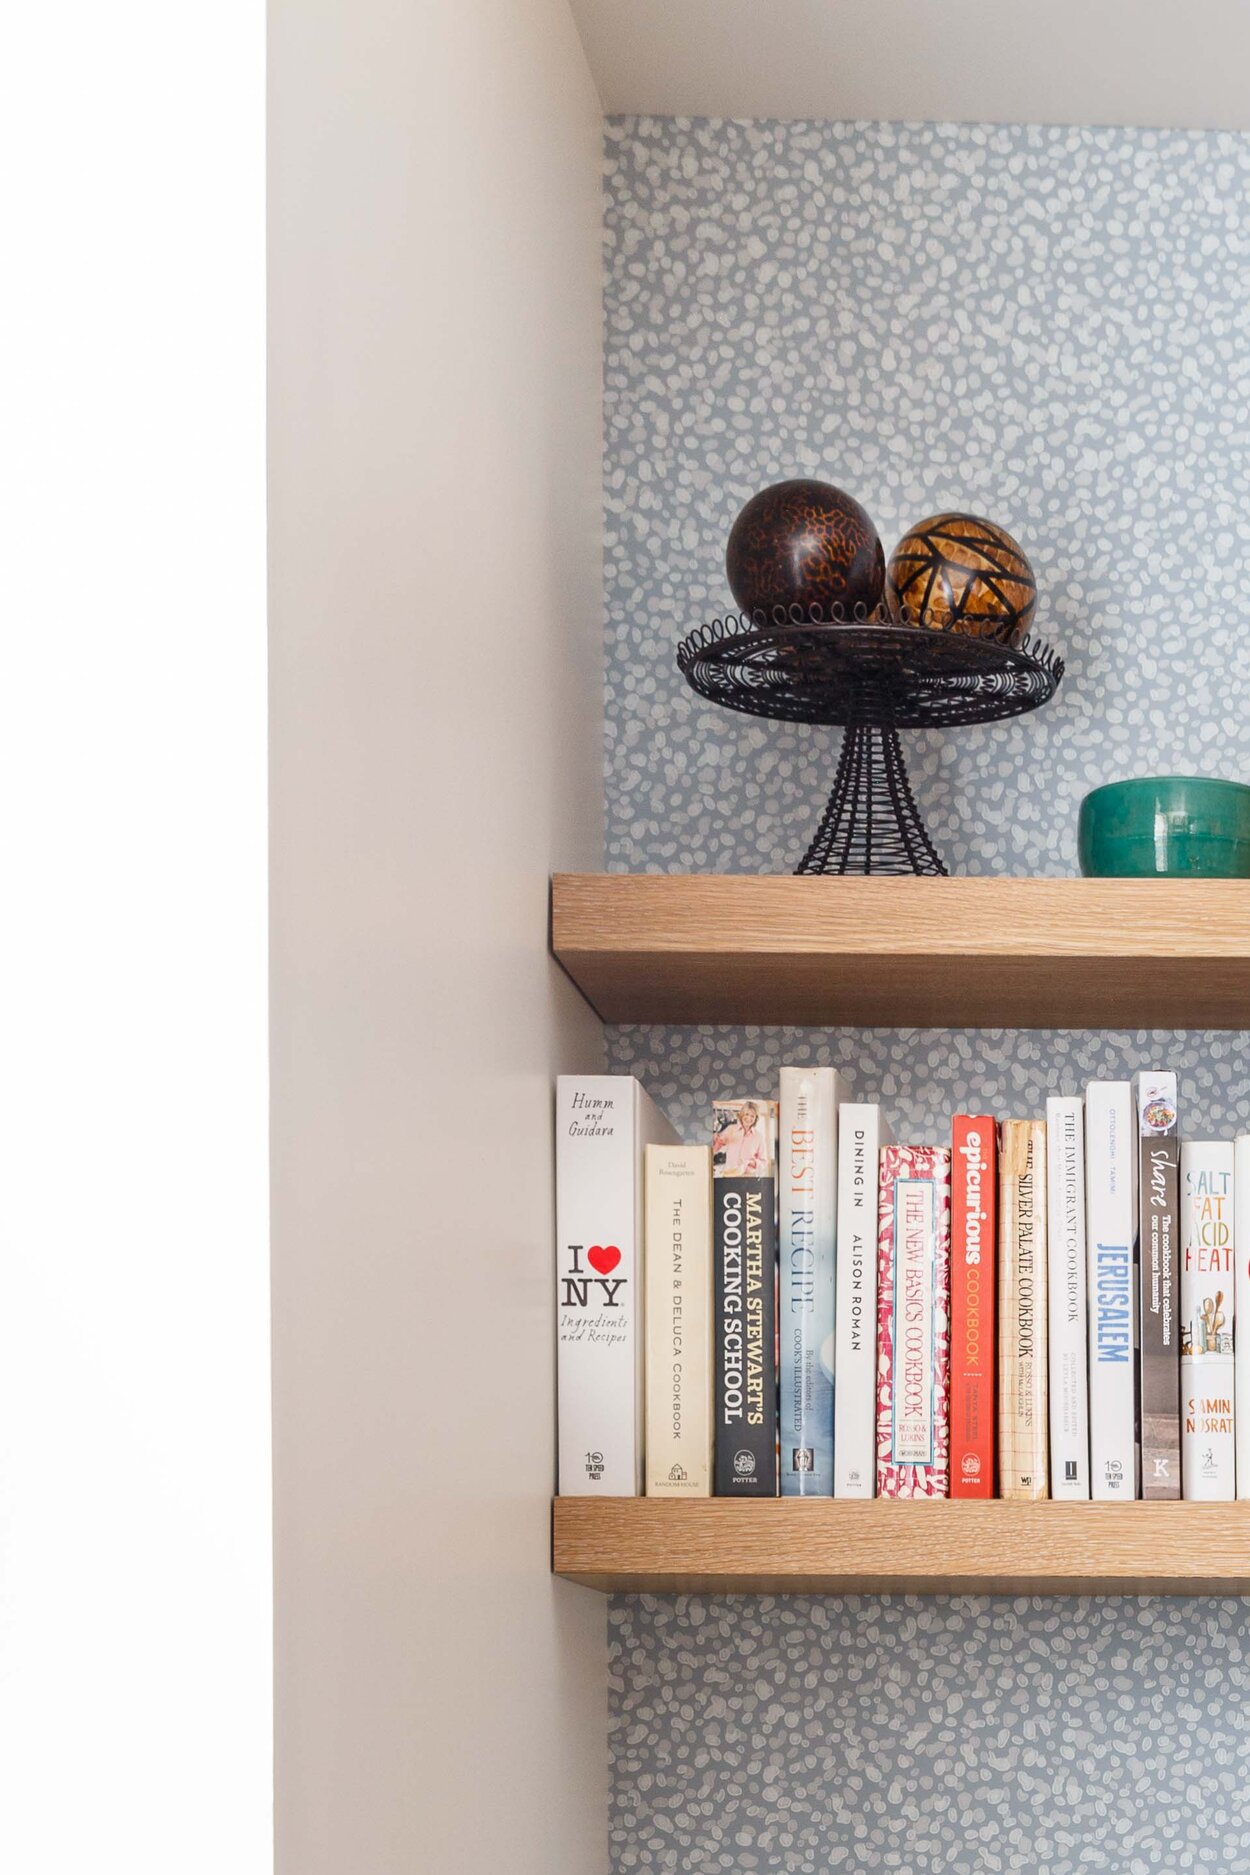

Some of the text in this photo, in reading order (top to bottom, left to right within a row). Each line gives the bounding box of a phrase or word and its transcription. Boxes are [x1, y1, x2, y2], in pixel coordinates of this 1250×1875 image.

[568, 1121, 614, 1136] Guidara
[571, 1092, 614, 1109] Humm
[584, 1110, 604, 1120] and
[791, 1130, 814, 1199] BEST
[853, 1130, 864, 1207] DINING IN
[1018, 1173, 1033, 1218] SILVER
[1150, 1150, 1177, 1207] share
[1187, 1171, 1231, 1196] SALT
[959, 1131, 987, 1366] epicurious COOKBOOK
[1018, 1222, 1033, 1274] PALATE
[1065, 1113, 1078, 1322] THE IMMIGRANT COOKBOOK
[561, 1278, 628, 1307] NY
[567, 1245, 584, 1273] I
[791, 1211, 814, 1313] RECIPE
[851, 1235, 862, 1350] ALISON ROMAN
[1150, 1215, 1161, 1314] our common humanity
[1162, 1215, 1172, 1346] The cookbook that celebrates
[561, 1313, 628, 1334] Ingredients
[561, 1328, 626, 1346] and Recipes
[673, 1199, 681, 1440] THE DEAN & DELUCA COOKBOOK
[723, 1192, 743, 1424] COOKING SCHOOL
[746, 1192, 763, 1425] MARTHA STEWART'S
[905, 1191, 923, 1416] THE NEW BASICS COOKBOOK
[1018, 1277, 1033, 1358] COOKBOOK
[1097, 1244, 1129, 1362] JERUSALEM
[793, 1367, 802, 1432] ILLUSTRATED
[1153, 1459, 1170, 1477] K
